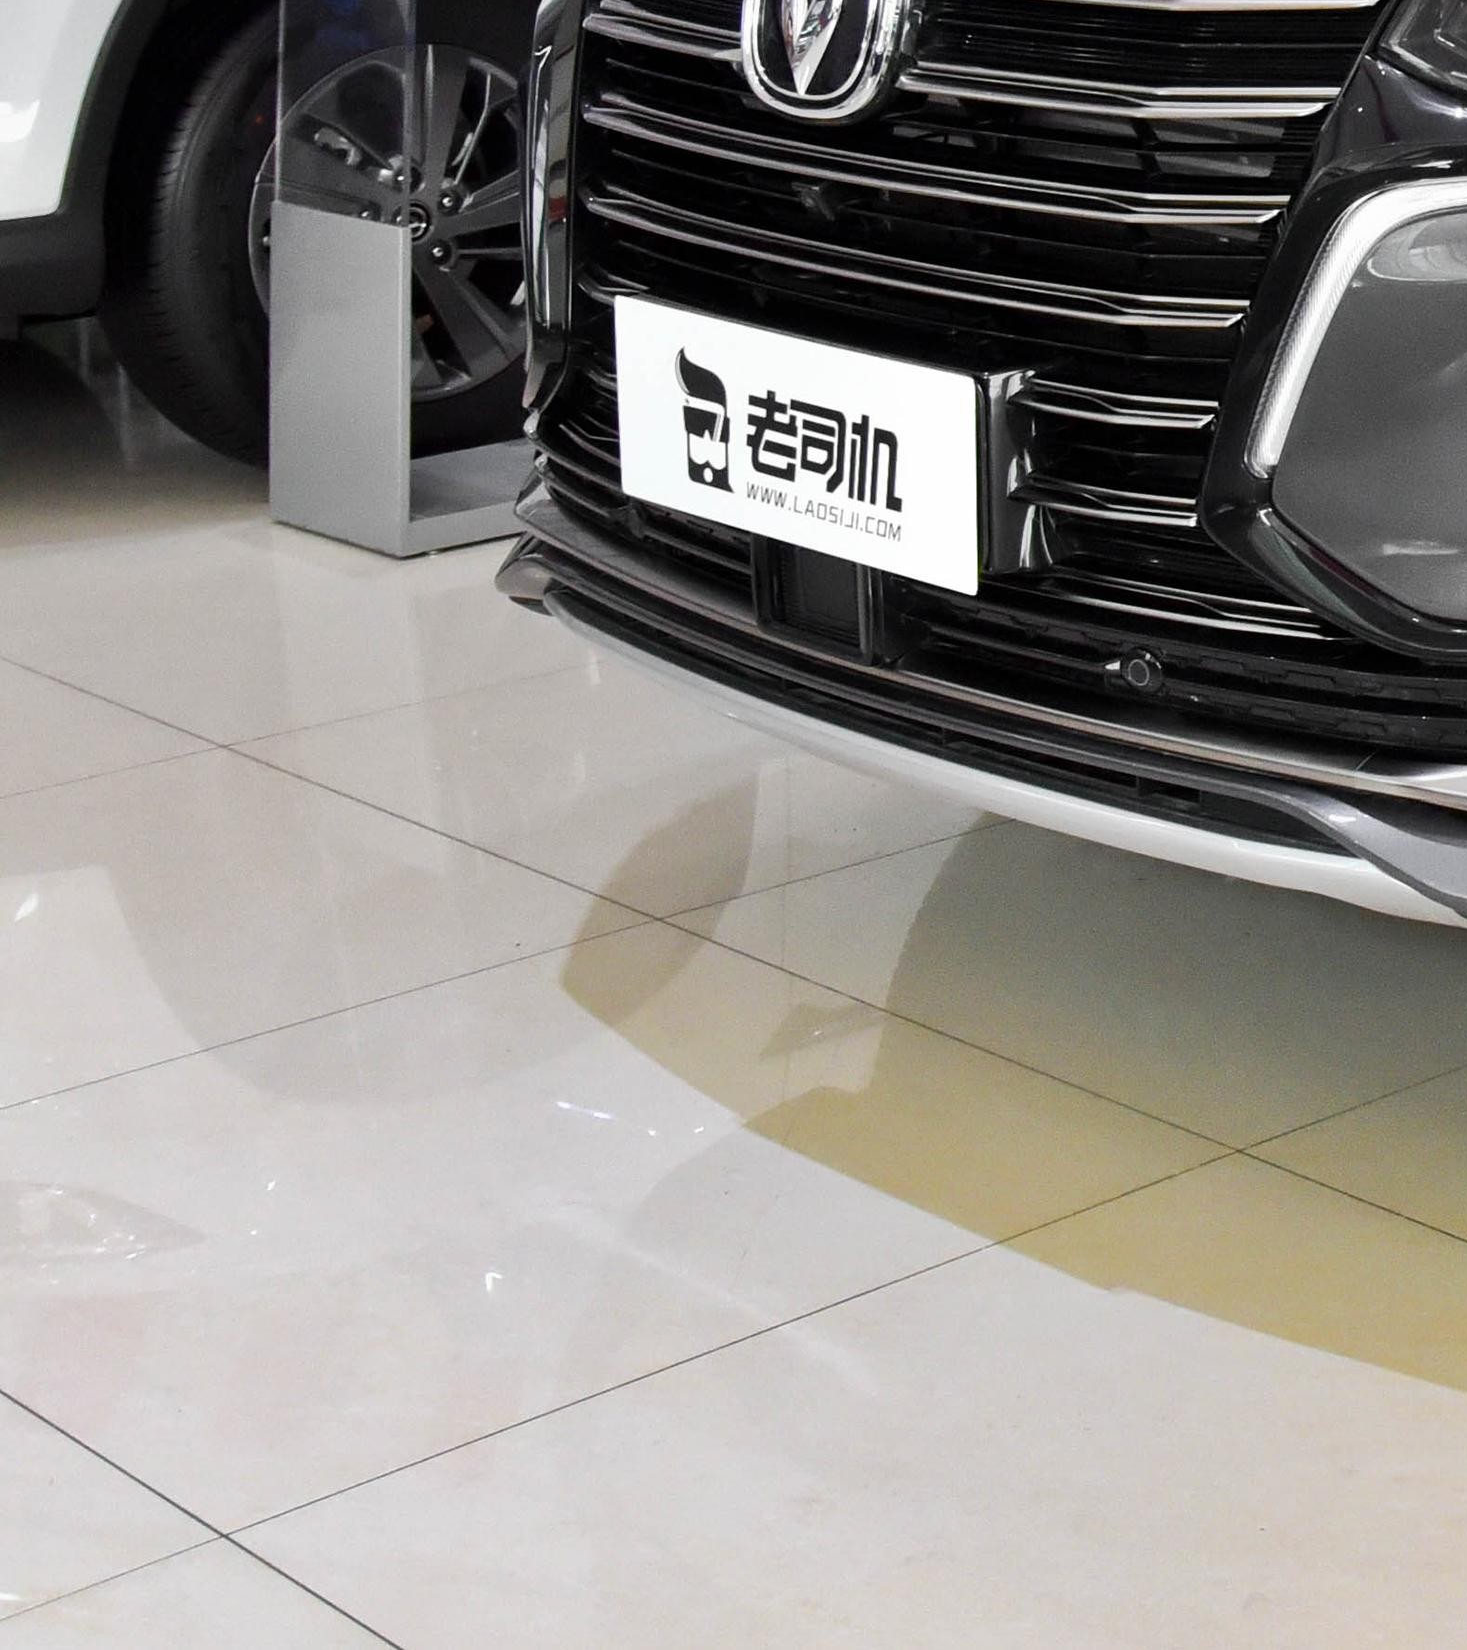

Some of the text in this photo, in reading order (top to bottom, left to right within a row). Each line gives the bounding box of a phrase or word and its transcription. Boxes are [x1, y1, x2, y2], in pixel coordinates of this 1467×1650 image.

[746, 390, 903, 513] 老司机
[746, 481, 902, 542] WWW.LAOSIJI.COM
